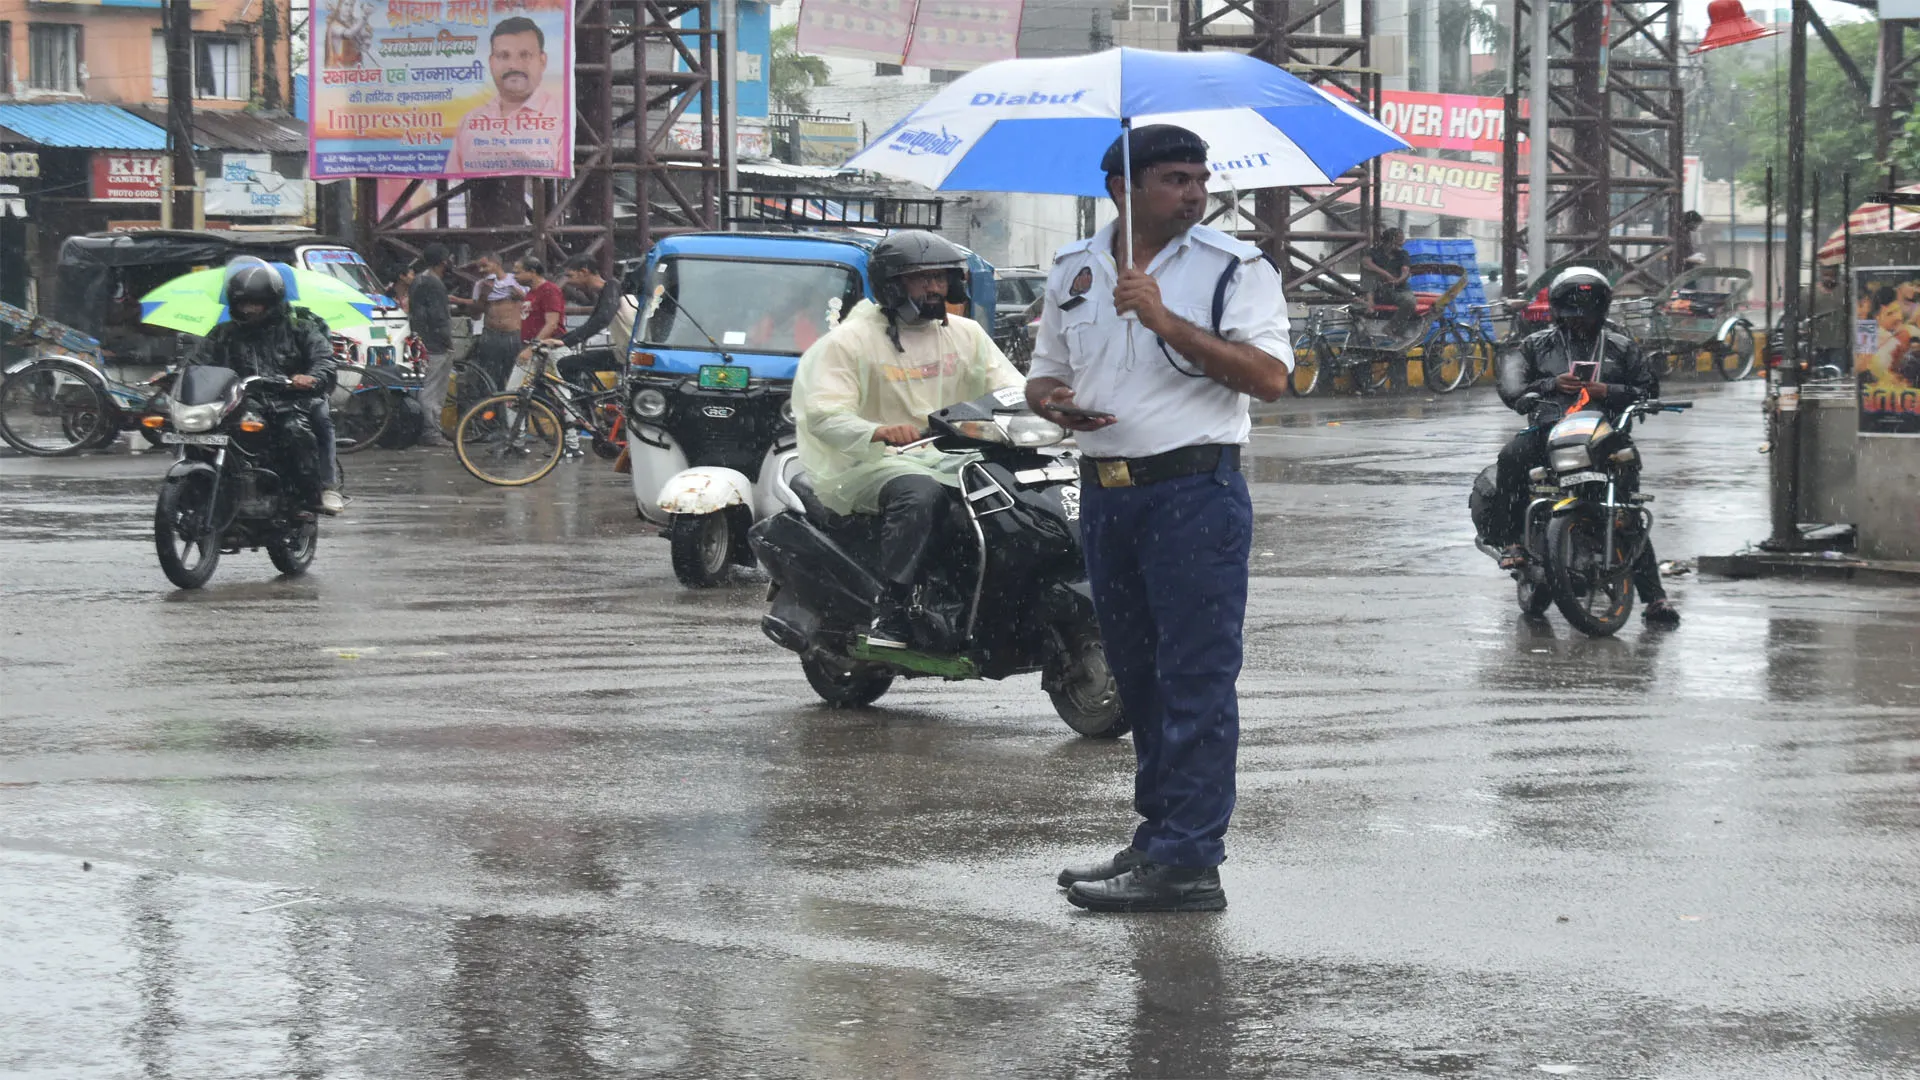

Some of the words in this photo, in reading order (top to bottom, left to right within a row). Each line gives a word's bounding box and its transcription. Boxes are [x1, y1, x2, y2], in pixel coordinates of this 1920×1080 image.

[386, 63, 408, 84] एवं
[411, 60, 485, 82] जन्माष्टमी
[328, 109, 444, 136] Impression
[469, 114, 513, 136] मोनू
[516, 112, 558, 131] सिंह
[1380, 102, 1444, 138] OVER
[400, 129, 443, 145] Arts
[1388, 160, 1501, 193] BANQUE
[1381, 182, 1445, 209] HALL
